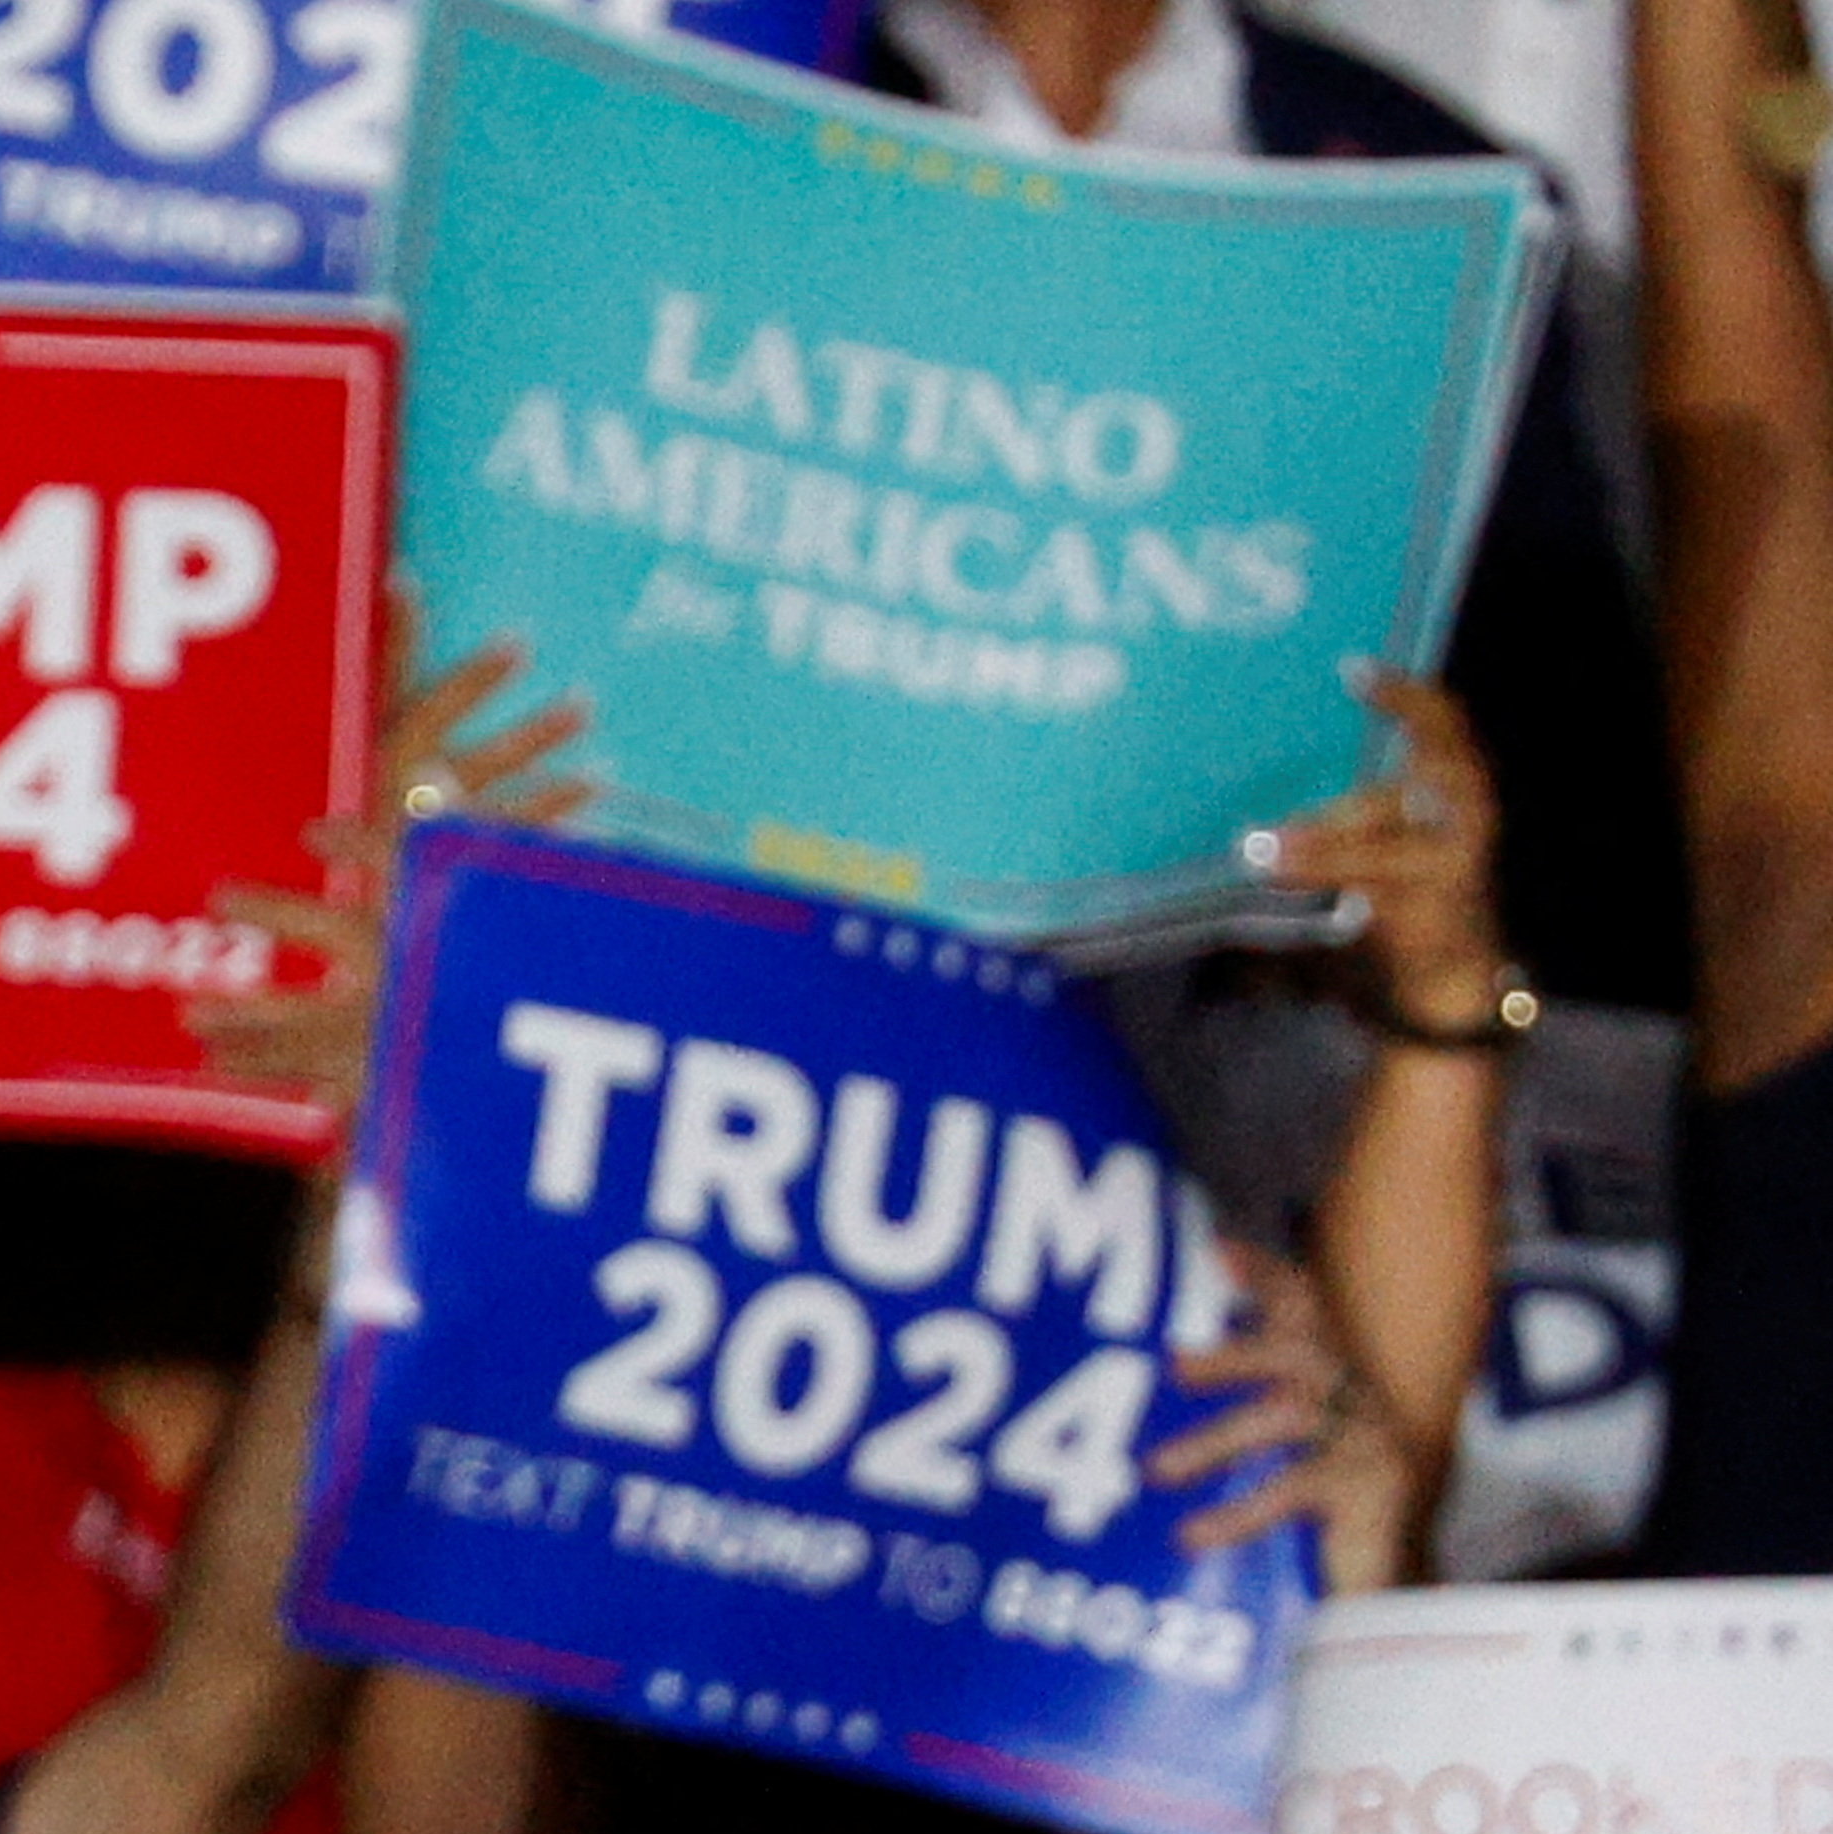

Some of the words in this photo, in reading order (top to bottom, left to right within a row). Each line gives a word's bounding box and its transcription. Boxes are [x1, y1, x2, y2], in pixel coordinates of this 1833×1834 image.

[645, 287, 1182, 506] LATINO
[485, 387, 1313, 635] AMERICANS
[756, 580, 1127, 713] TRUMP
[555, 1235, 1157, 1546] 2024
[408, 1425, 615, 1536] TEXT
[608, 1468, 873, 1596] TRUMP
[878, 1522, 985, 1624] TO
